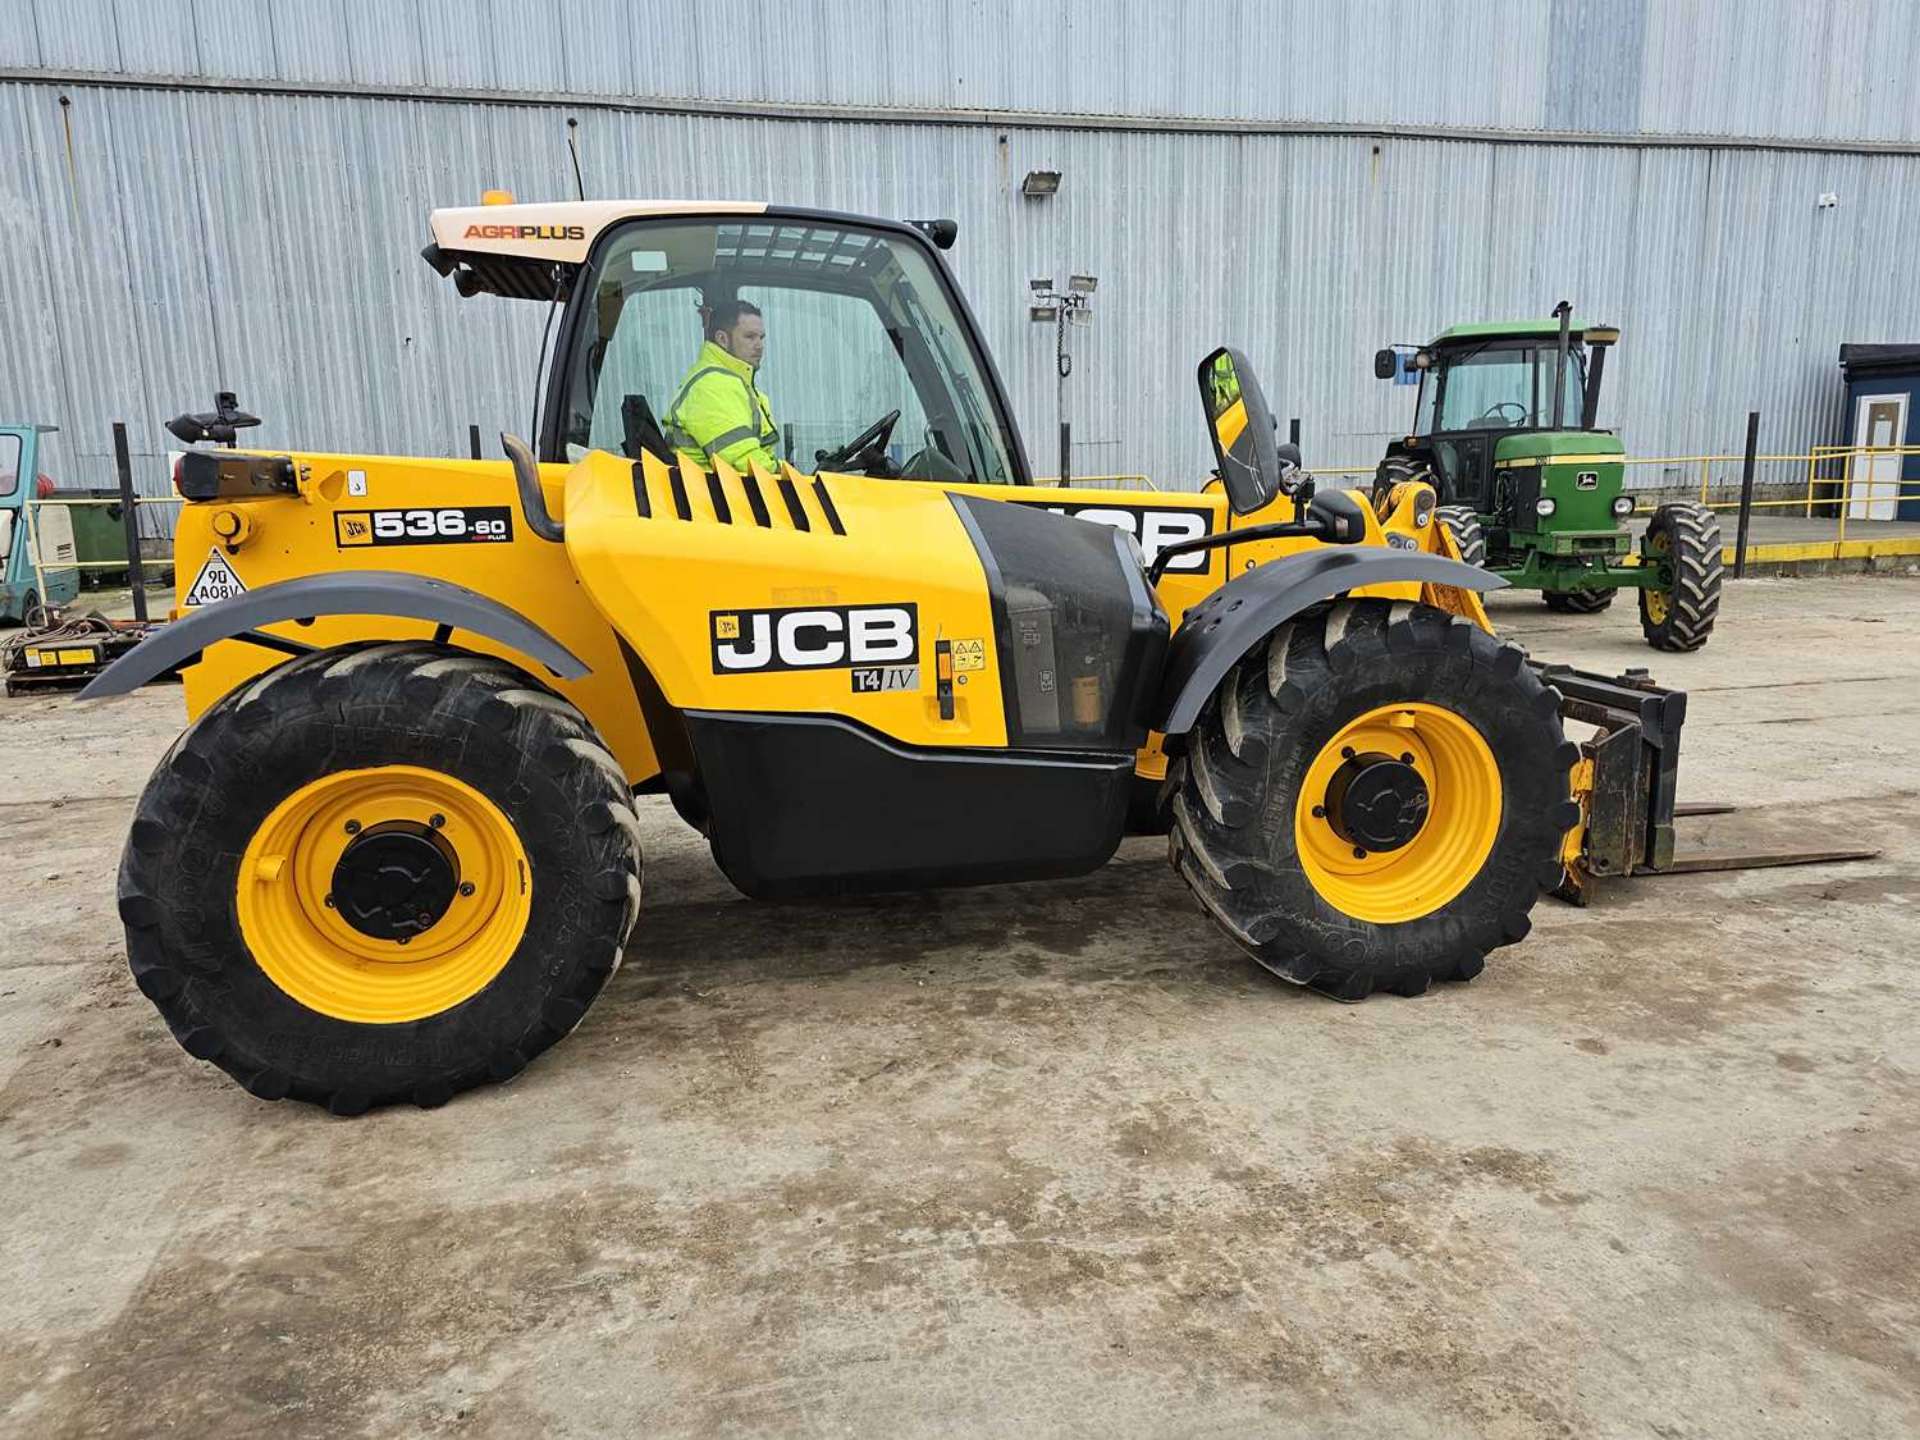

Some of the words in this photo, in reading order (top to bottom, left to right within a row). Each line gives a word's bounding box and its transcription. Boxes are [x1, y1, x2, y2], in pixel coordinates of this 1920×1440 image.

[464, 225, 584, 240] AGRIPLUS
[374, 510, 506, 537] 536-60
[718, 609, 914, 669] JCB
[854, 671, 880, 690] T4
[886, 669, 914, 689] IV
